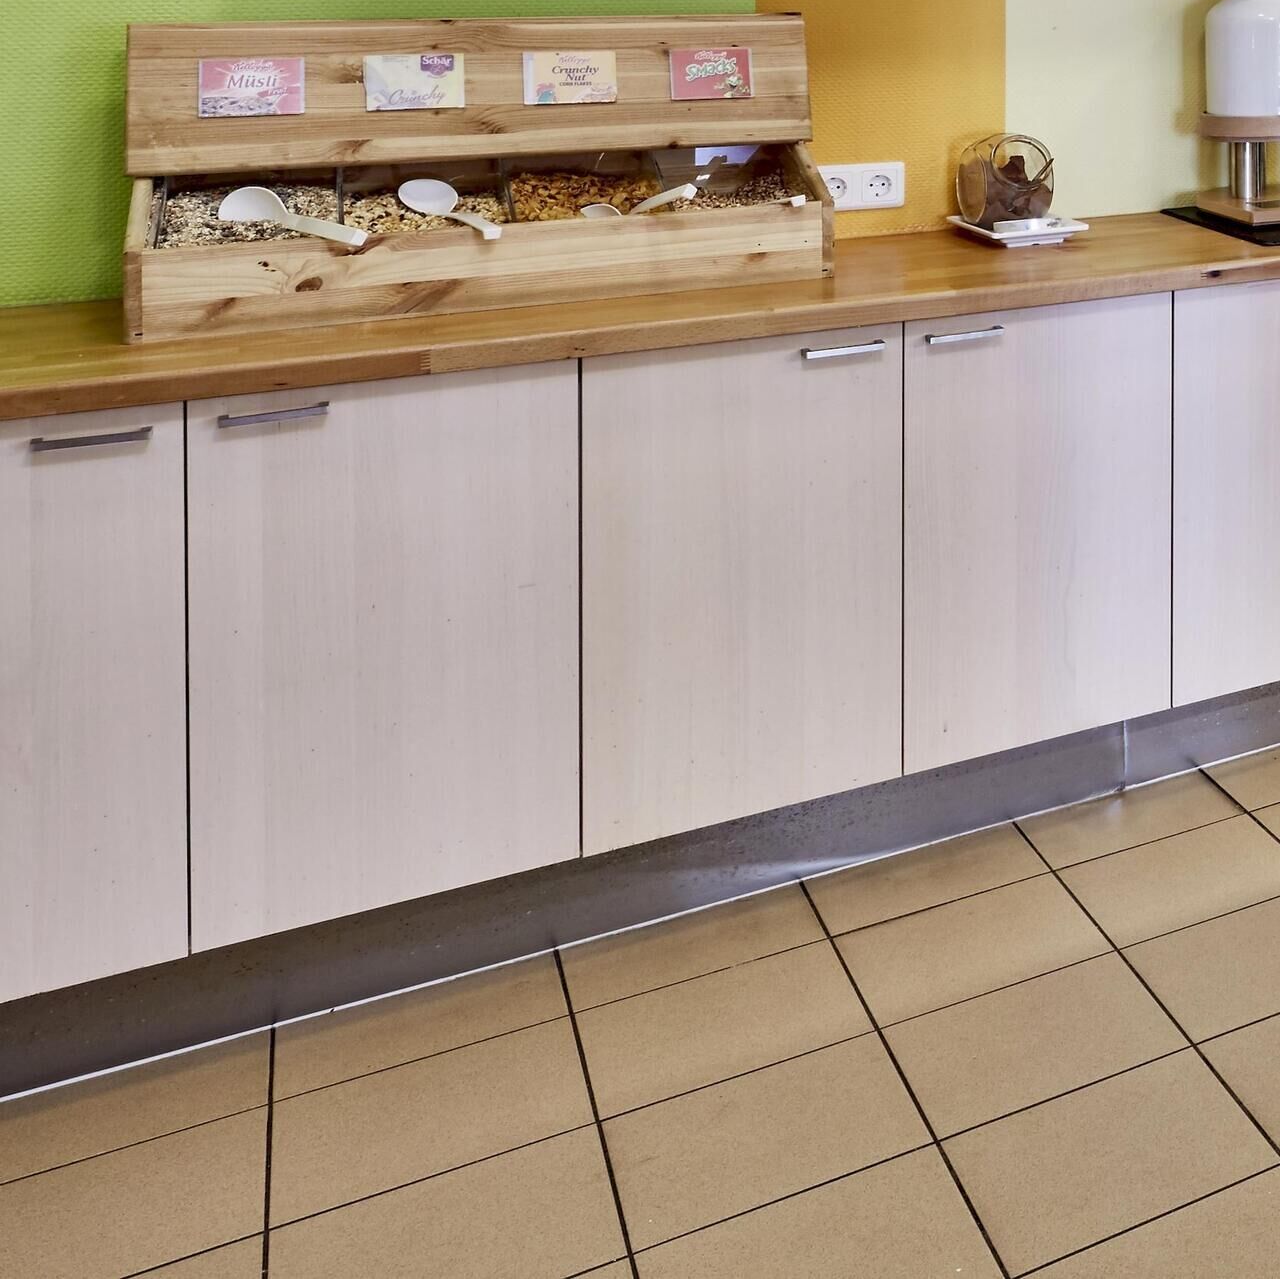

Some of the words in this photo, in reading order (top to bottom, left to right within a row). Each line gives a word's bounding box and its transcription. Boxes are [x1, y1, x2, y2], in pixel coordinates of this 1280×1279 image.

[422, 56, 453, 66] Schär
[552, 65, 599, 75] Crunchy
[227, 74, 278, 88] Müsli
[566, 73, 586, 81] Nut
[389, 84, 446, 105] Crunchy
